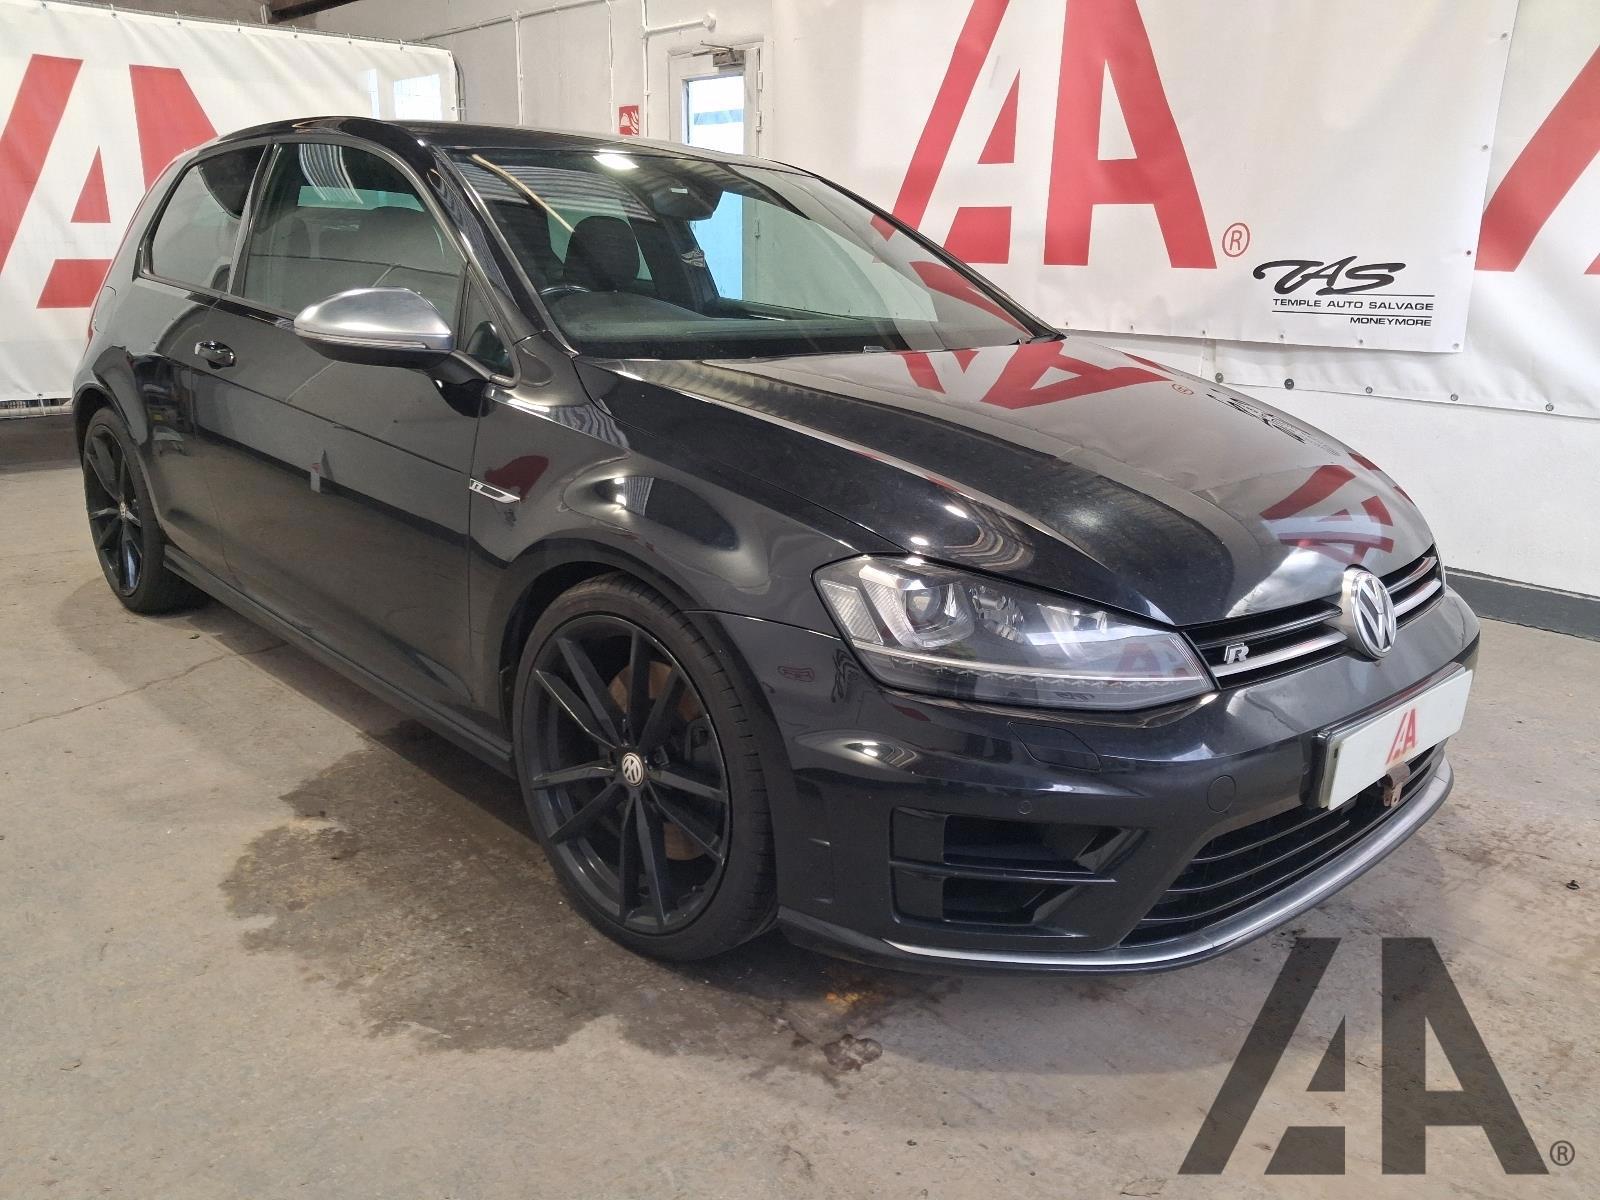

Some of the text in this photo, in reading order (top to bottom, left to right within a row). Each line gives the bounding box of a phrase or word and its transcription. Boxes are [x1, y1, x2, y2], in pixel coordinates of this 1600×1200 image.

[1253, 255, 1406, 296] TAS
[1273, 298, 1434, 311] TEMPLE AUTO SALVAGE
[1350, 316, 1432, 327] MONEYMORE
